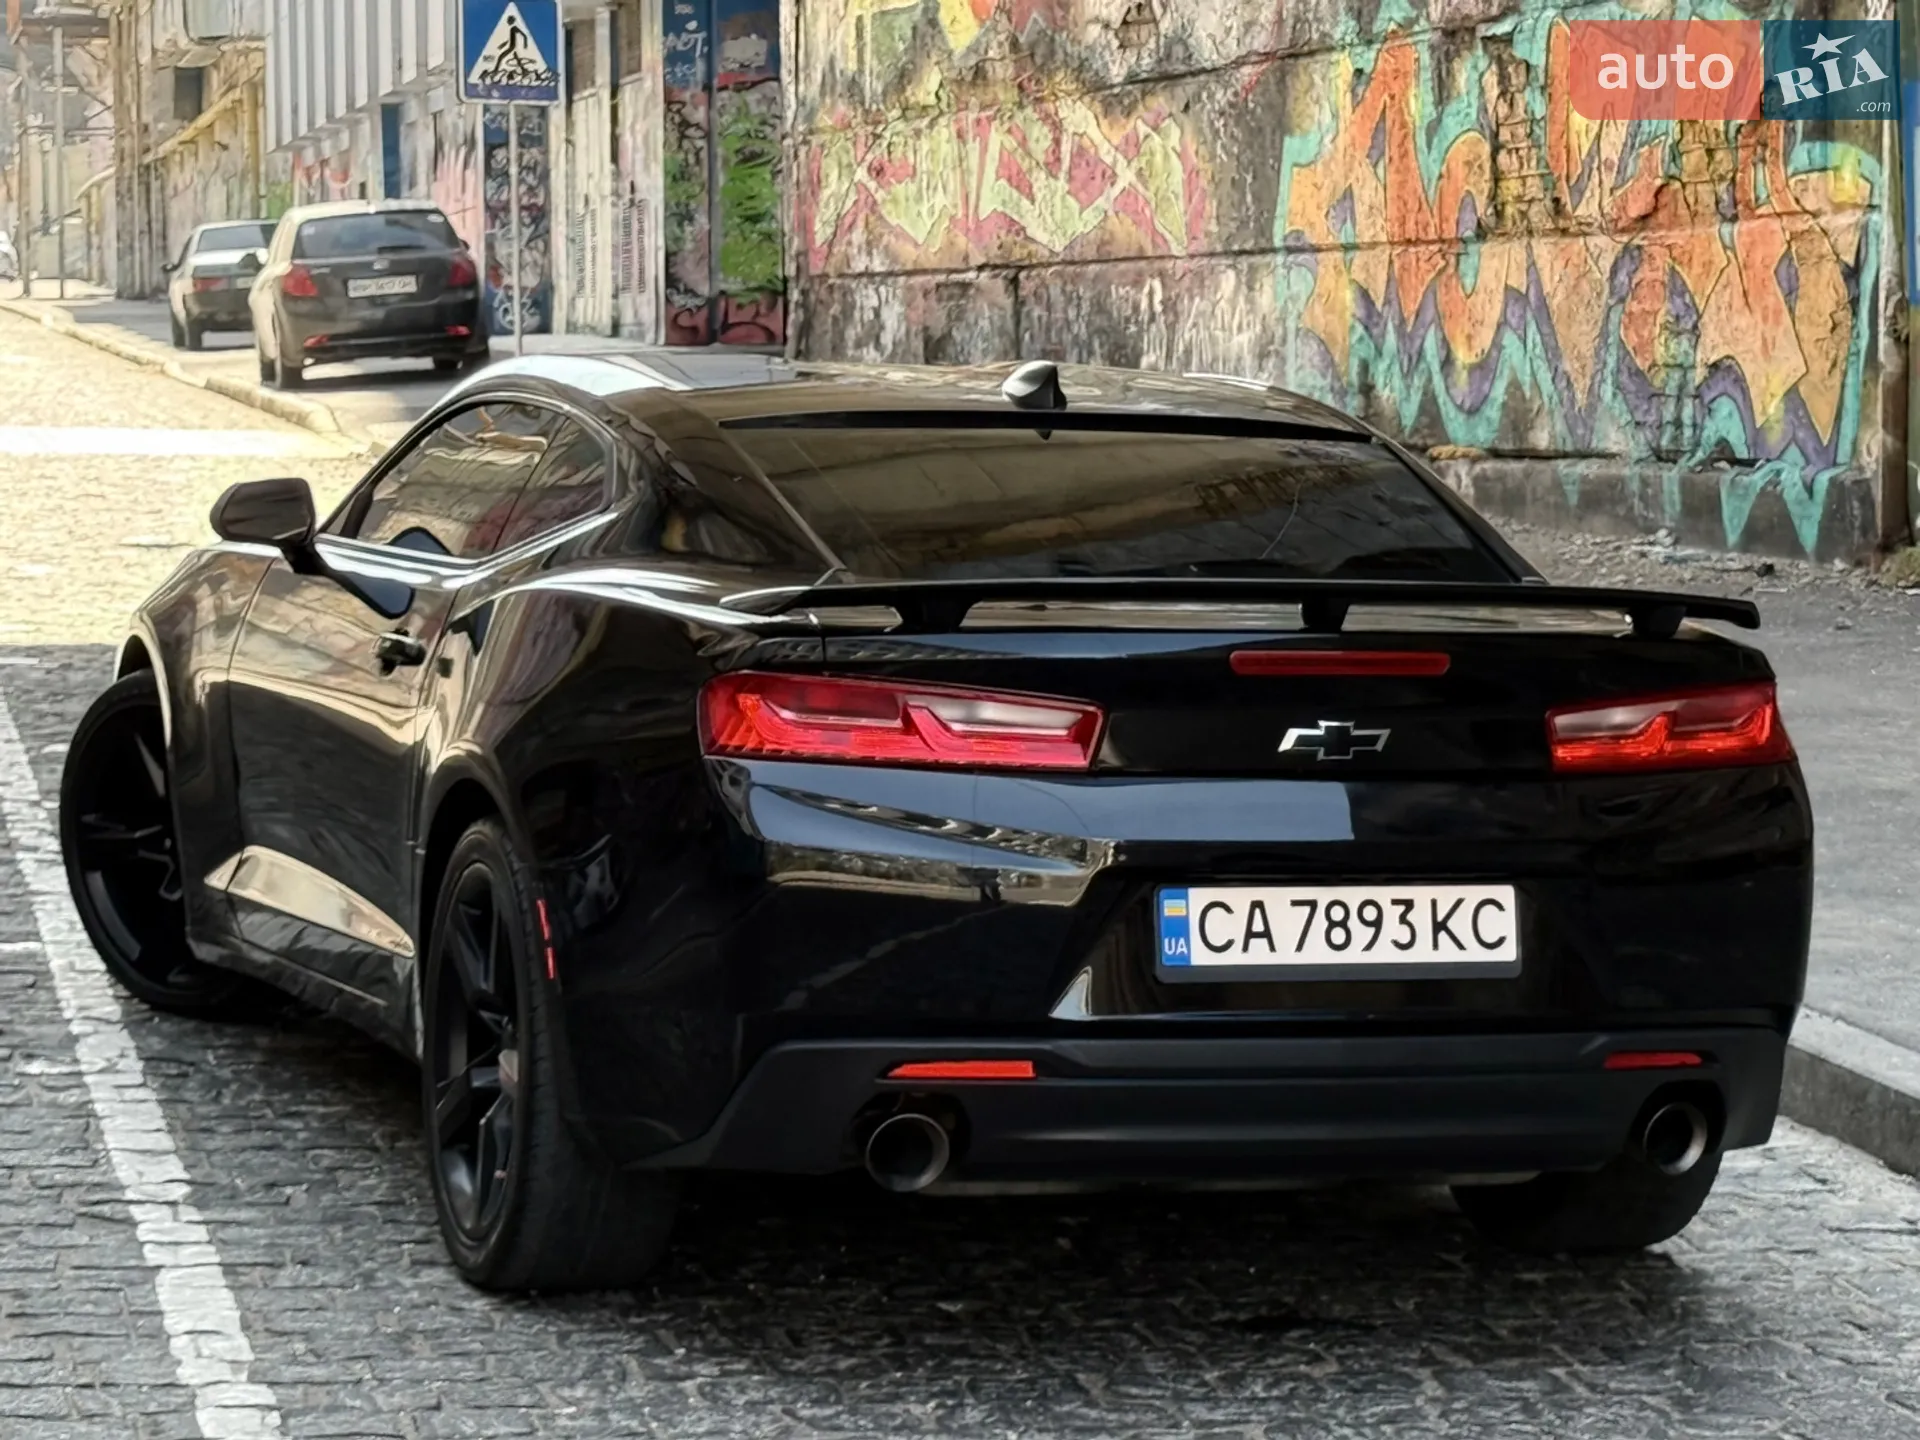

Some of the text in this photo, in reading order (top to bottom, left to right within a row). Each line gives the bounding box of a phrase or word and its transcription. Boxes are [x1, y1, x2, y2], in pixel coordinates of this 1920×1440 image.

[1199, 898, 1508, 953] CA 7893 KC
[1164, 937, 1188, 955] UA
